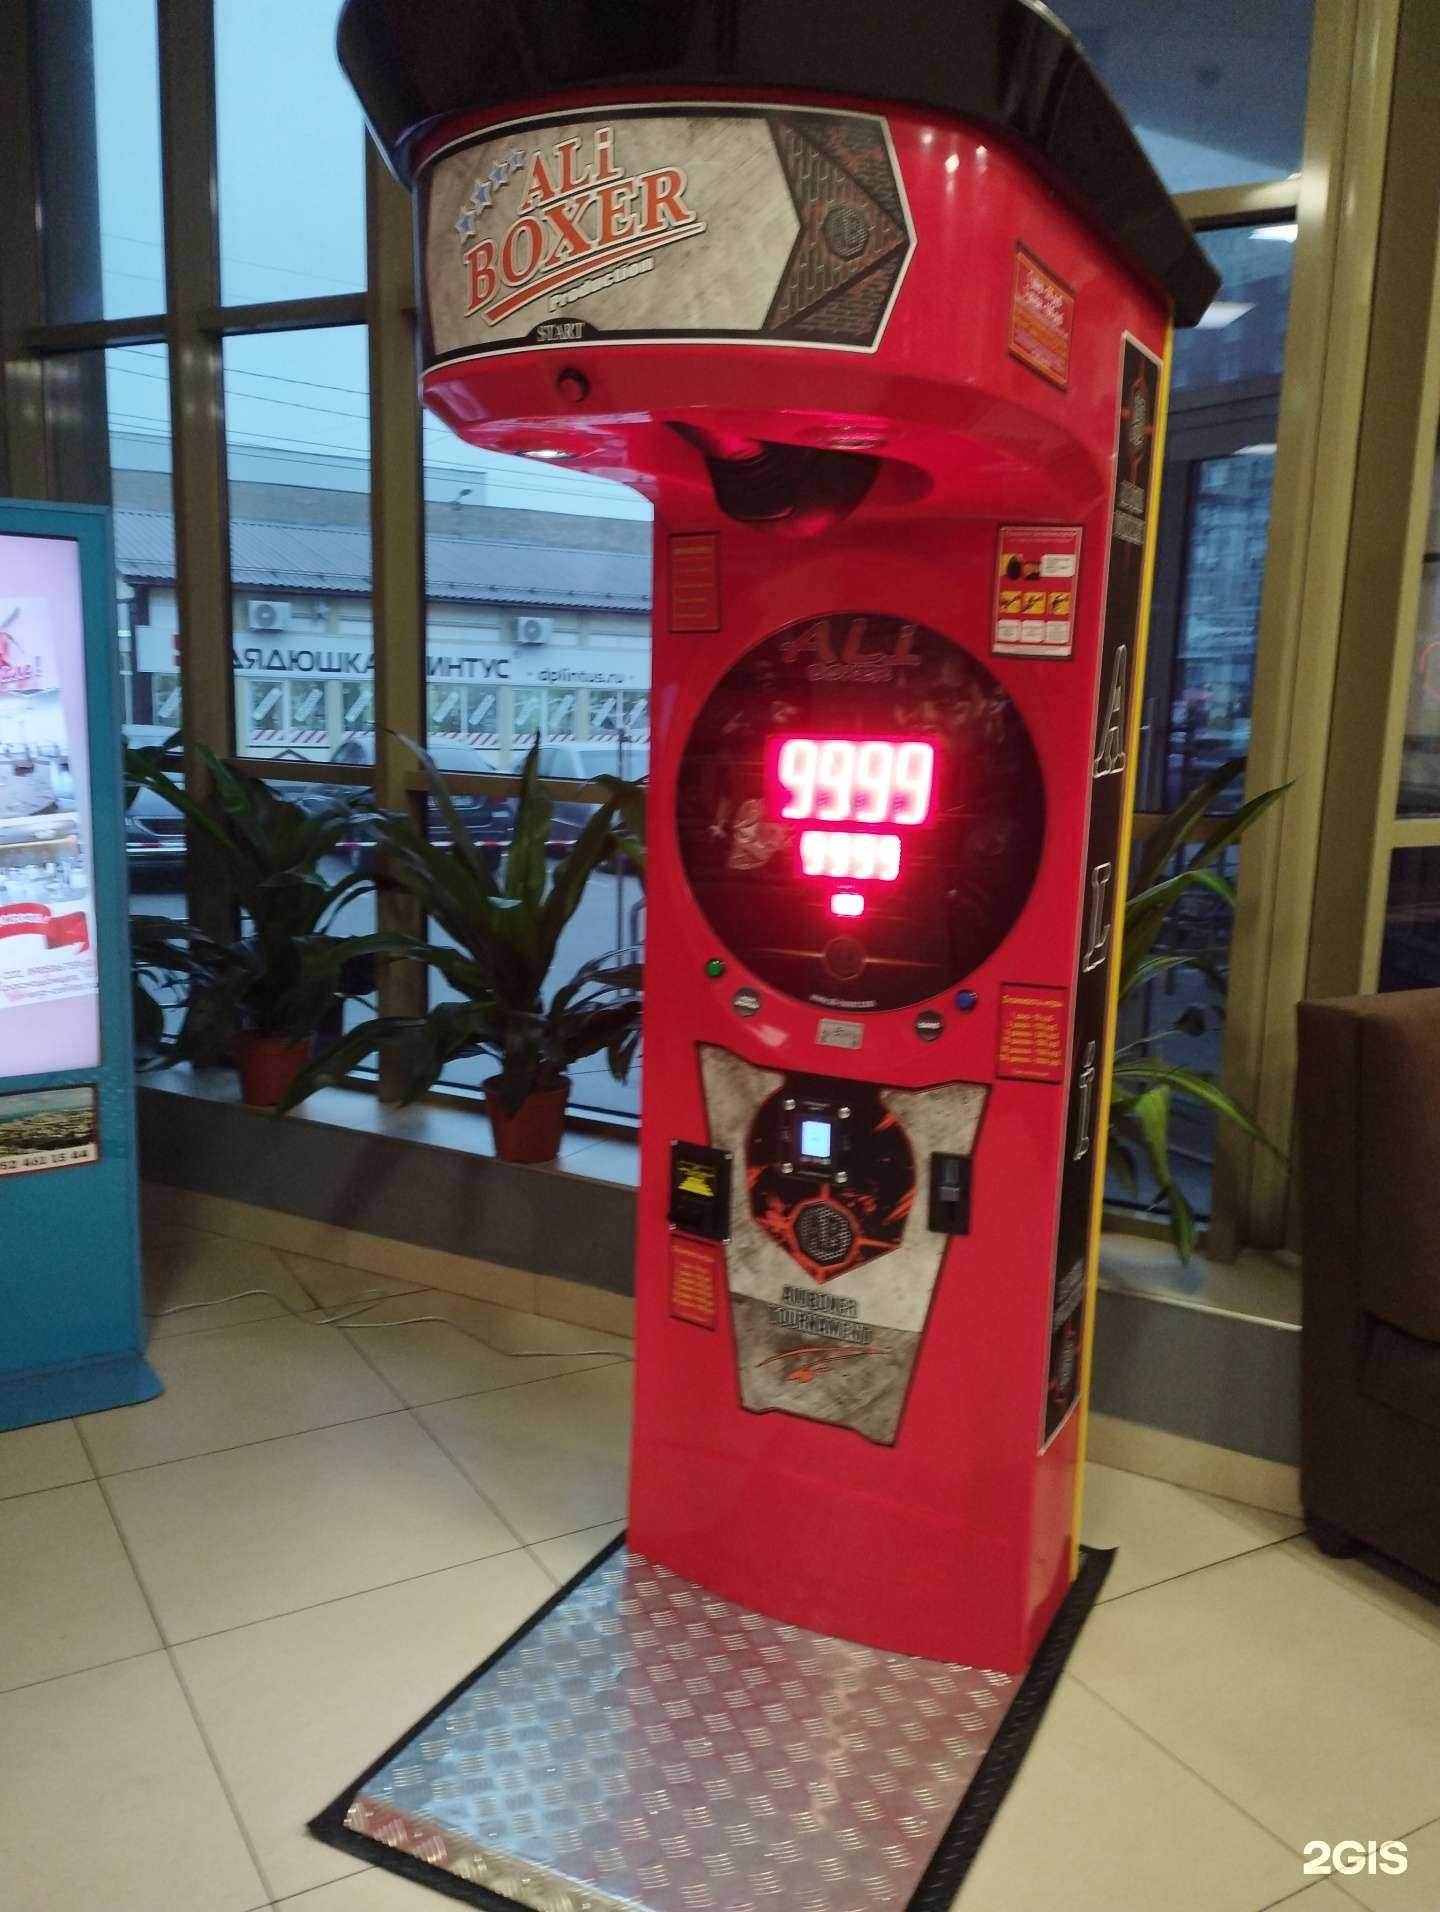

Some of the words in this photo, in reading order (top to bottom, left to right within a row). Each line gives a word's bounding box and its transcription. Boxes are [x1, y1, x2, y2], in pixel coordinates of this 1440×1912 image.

[463, 166, 698, 318] BOXER
[536, 321, 585, 341] START
[426, 656, 510, 680] ИНТУС
[777, 738, 935, 826] 9999
